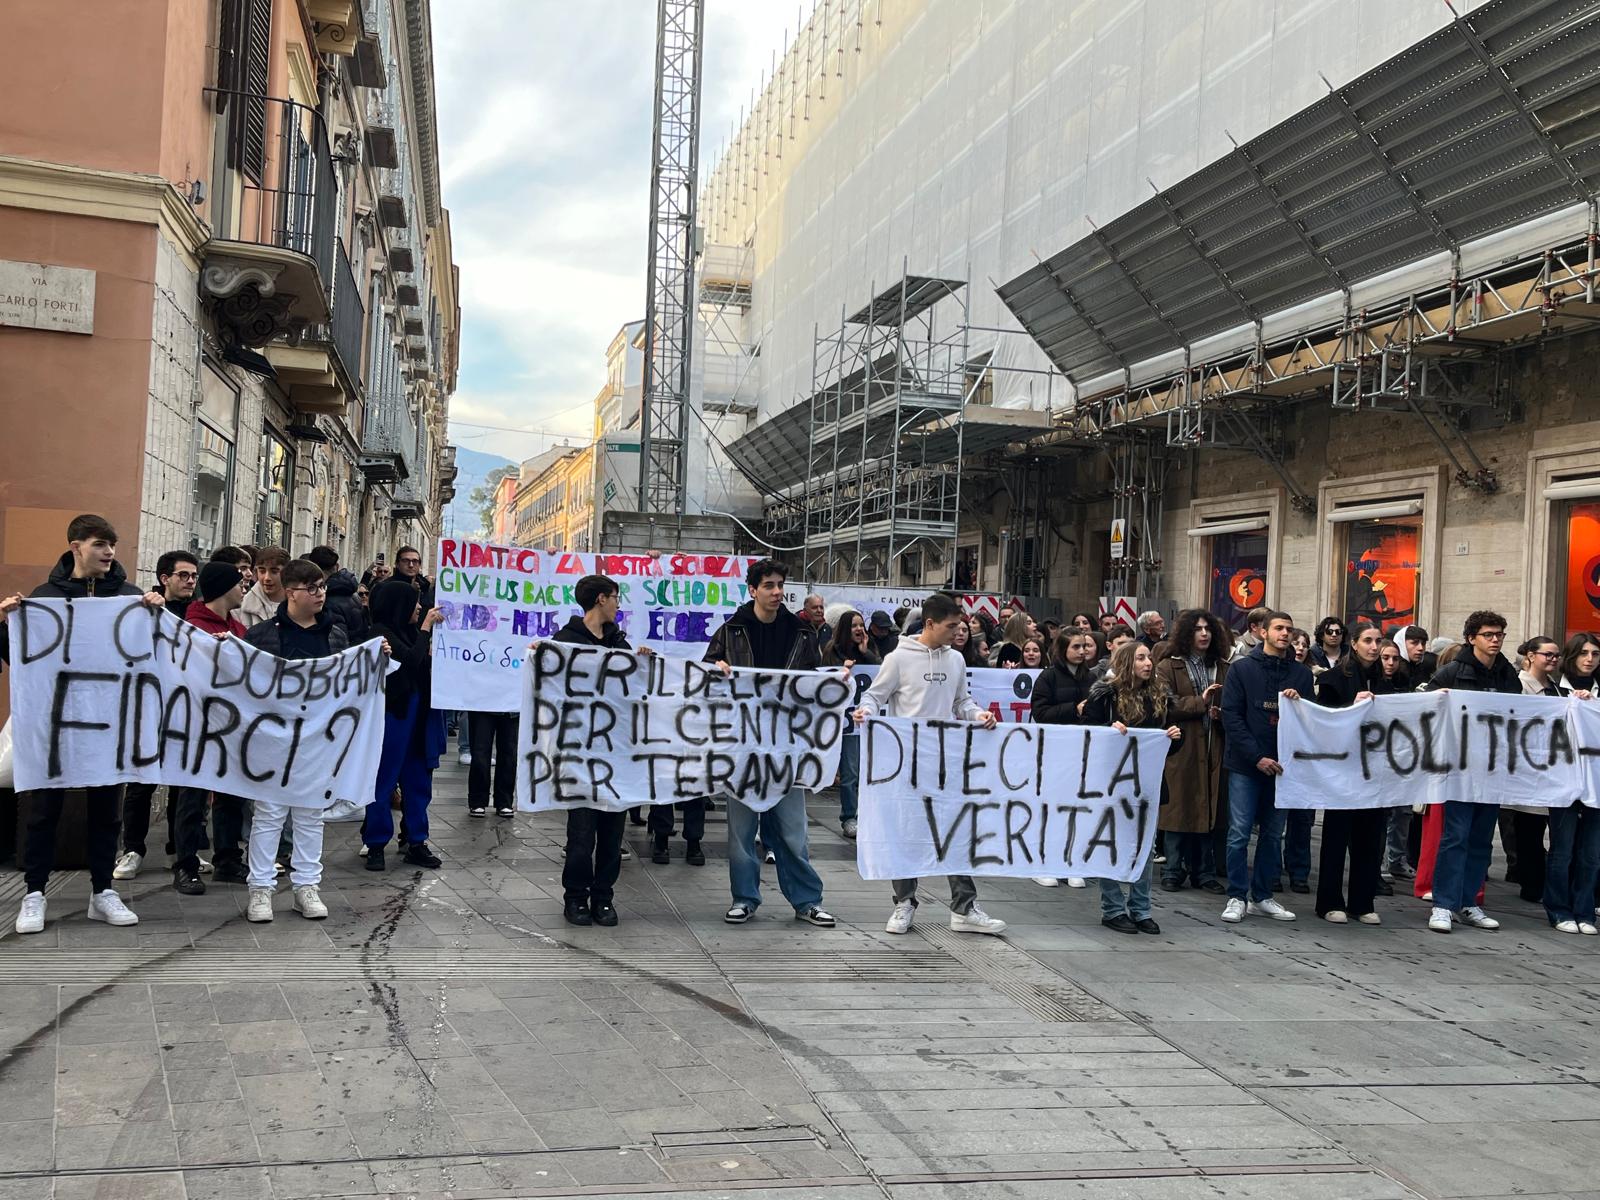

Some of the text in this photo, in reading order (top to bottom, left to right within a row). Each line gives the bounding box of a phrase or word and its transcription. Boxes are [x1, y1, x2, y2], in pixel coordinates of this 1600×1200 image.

[32, 277, 48, 286] VIA
[44, 298, 79, 312] FORTI
[439, 567, 491, 598] GIVE
[495, 577, 519, 602] US
[441, 539, 757, 578] RIDATECI LA NOSTRA SCUOLA
[114, 601, 196, 670] CHI
[534, 642, 637, 697] PER
[647, 651, 675, 696] IL
[532, 697, 616, 752] PER
[631, 696, 671, 745] IL
[675, 701, 841, 750] CENTRO
[526, 750, 822, 804] PER TERAMO
[867, 719, 1141, 798] DITECI LA
